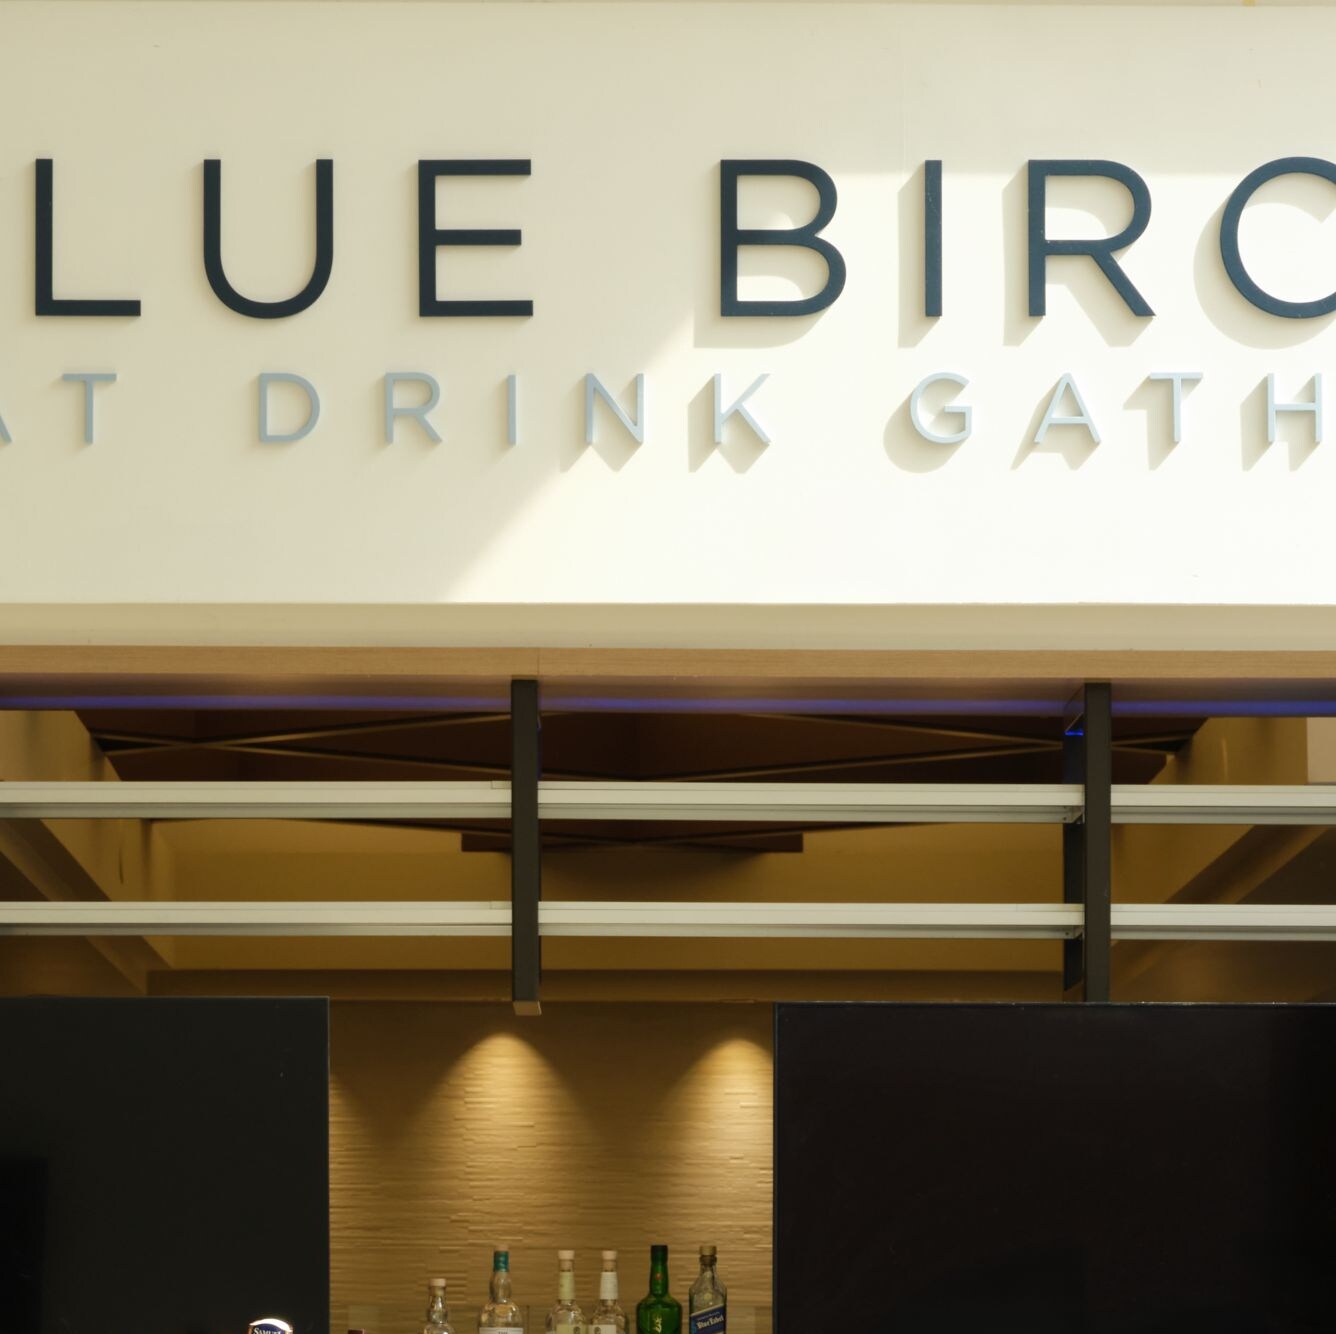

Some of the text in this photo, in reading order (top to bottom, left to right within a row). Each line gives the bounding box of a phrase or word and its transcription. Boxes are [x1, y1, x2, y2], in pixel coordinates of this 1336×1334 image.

[35, 156, 1336, 319] LUE BIRC
[257, 371, 772, 445] DRINK
[909, 371, 1322, 445] GATH
